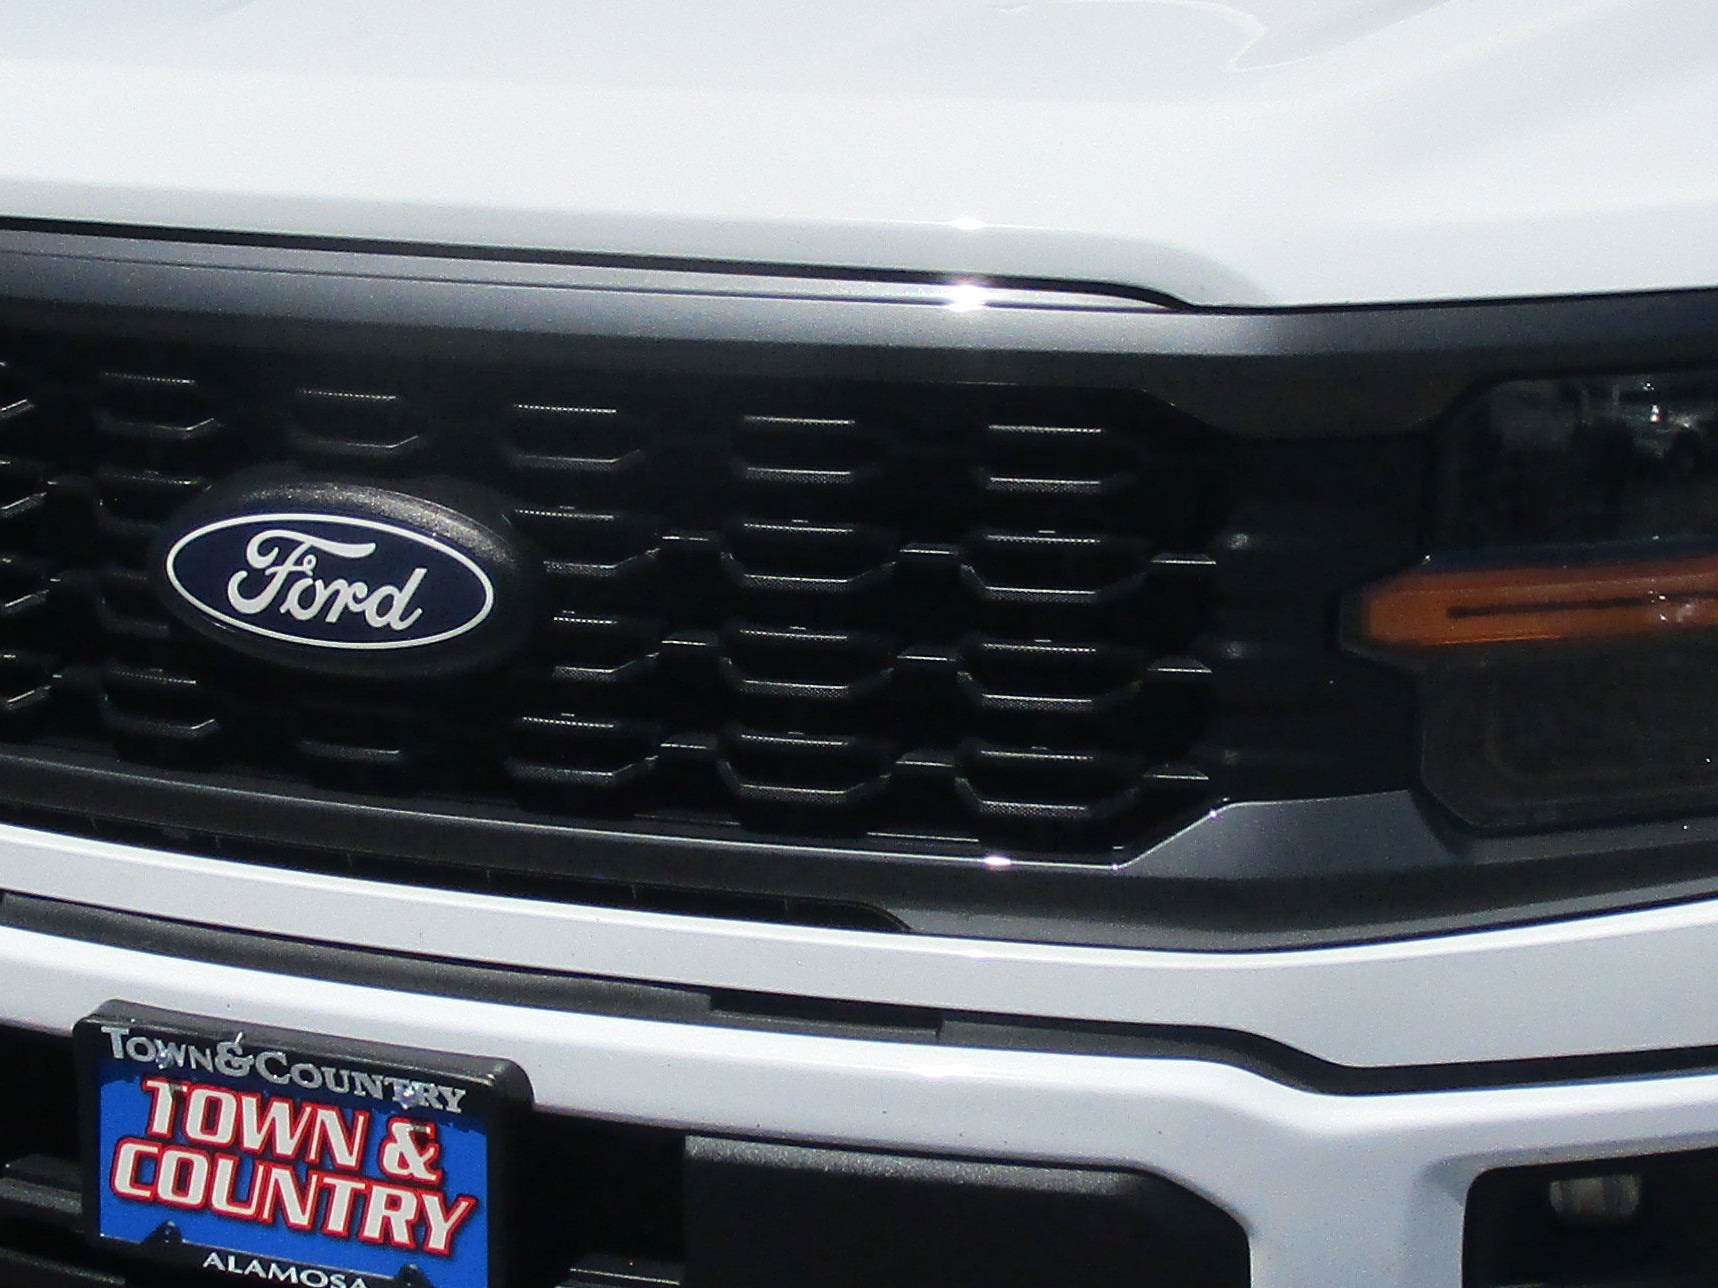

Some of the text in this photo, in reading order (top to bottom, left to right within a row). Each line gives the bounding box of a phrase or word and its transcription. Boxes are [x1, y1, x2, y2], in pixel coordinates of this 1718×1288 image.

[227, 528, 428, 631] Ford
[142, 1076, 444, 1184] TOWN &
[110, 1136, 477, 1256] COUNTRY
